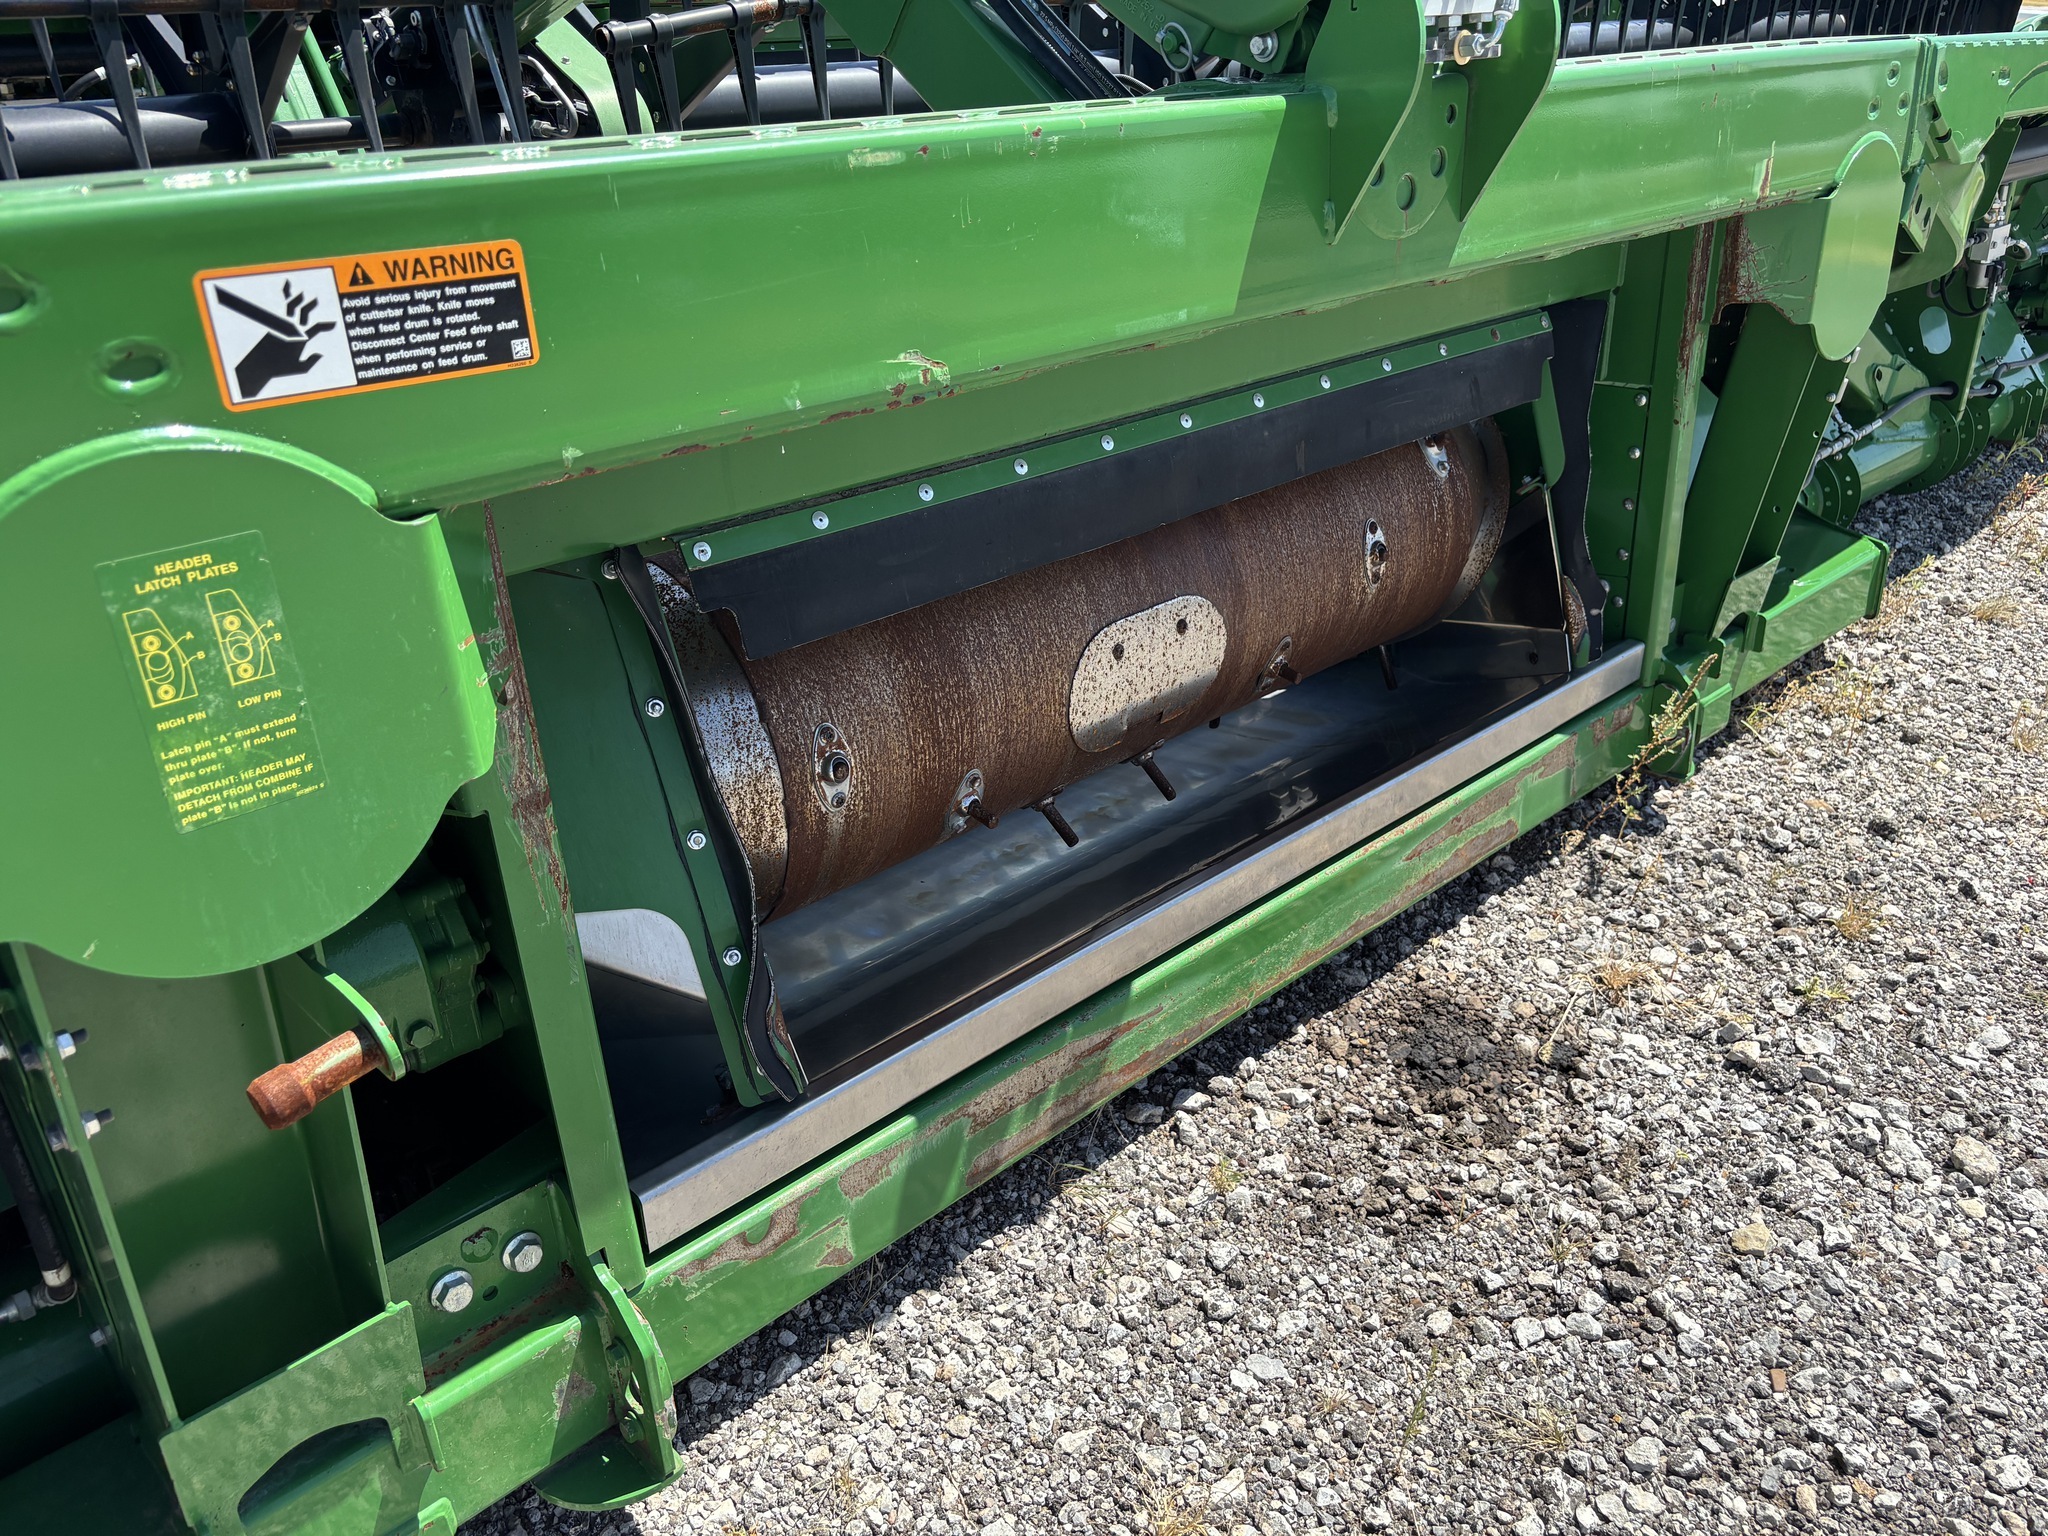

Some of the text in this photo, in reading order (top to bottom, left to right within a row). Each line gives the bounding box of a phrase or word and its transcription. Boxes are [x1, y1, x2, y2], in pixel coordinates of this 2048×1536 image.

[382, 248, 516, 282] WARNING
[342, 279, 516, 308] Avoid serious injury from movement
[345, 297, 495, 322] of cutterbar knife. Knife moves
[348, 311, 480, 337] when feed drum is rotated.
[351, 319, 519, 351] Disconnect Center Feed drive shaft
[354, 339, 486, 365] when performing service or
[357, 353, 488, 379] maintenance on feed drum.
[135, 562, 238, 594] LATCH PLATES
[154, 554, 212, 576] HEADER
[186, 631, 194, 640] A
[266, 619, 275, 628] A
[273, 632, 282, 641] B
[196, 651, 206, 660] B
[237, 689, 282, 708] LOW PIN
[157, 711, 206, 731] HIGH PIN
[160, 745, 192, 760] Latch
[194, 740, 212, 752] pin
[234, 724, 260, 738] must
[262, 713, 297, 730] extend
[164, 760, 188, 772] thru
[190, 751, 217, 766] plate
[253, 734, 274, 745] not,
[275, 727, 297, 739] turn
[168, 763, 225, 786] plate over.
[173, 753, 305, 801] IMPORTANT: HEADER MAY
[177, 763, 313, 813] DETACH FROM COMBINE IF
[181, 811, 207, 827] plate
[228, 801, 239, 810] is
[240, 794, 258, 806] not
[259, 791, 269, 799] in
[271, 782, 301, 797] place.
